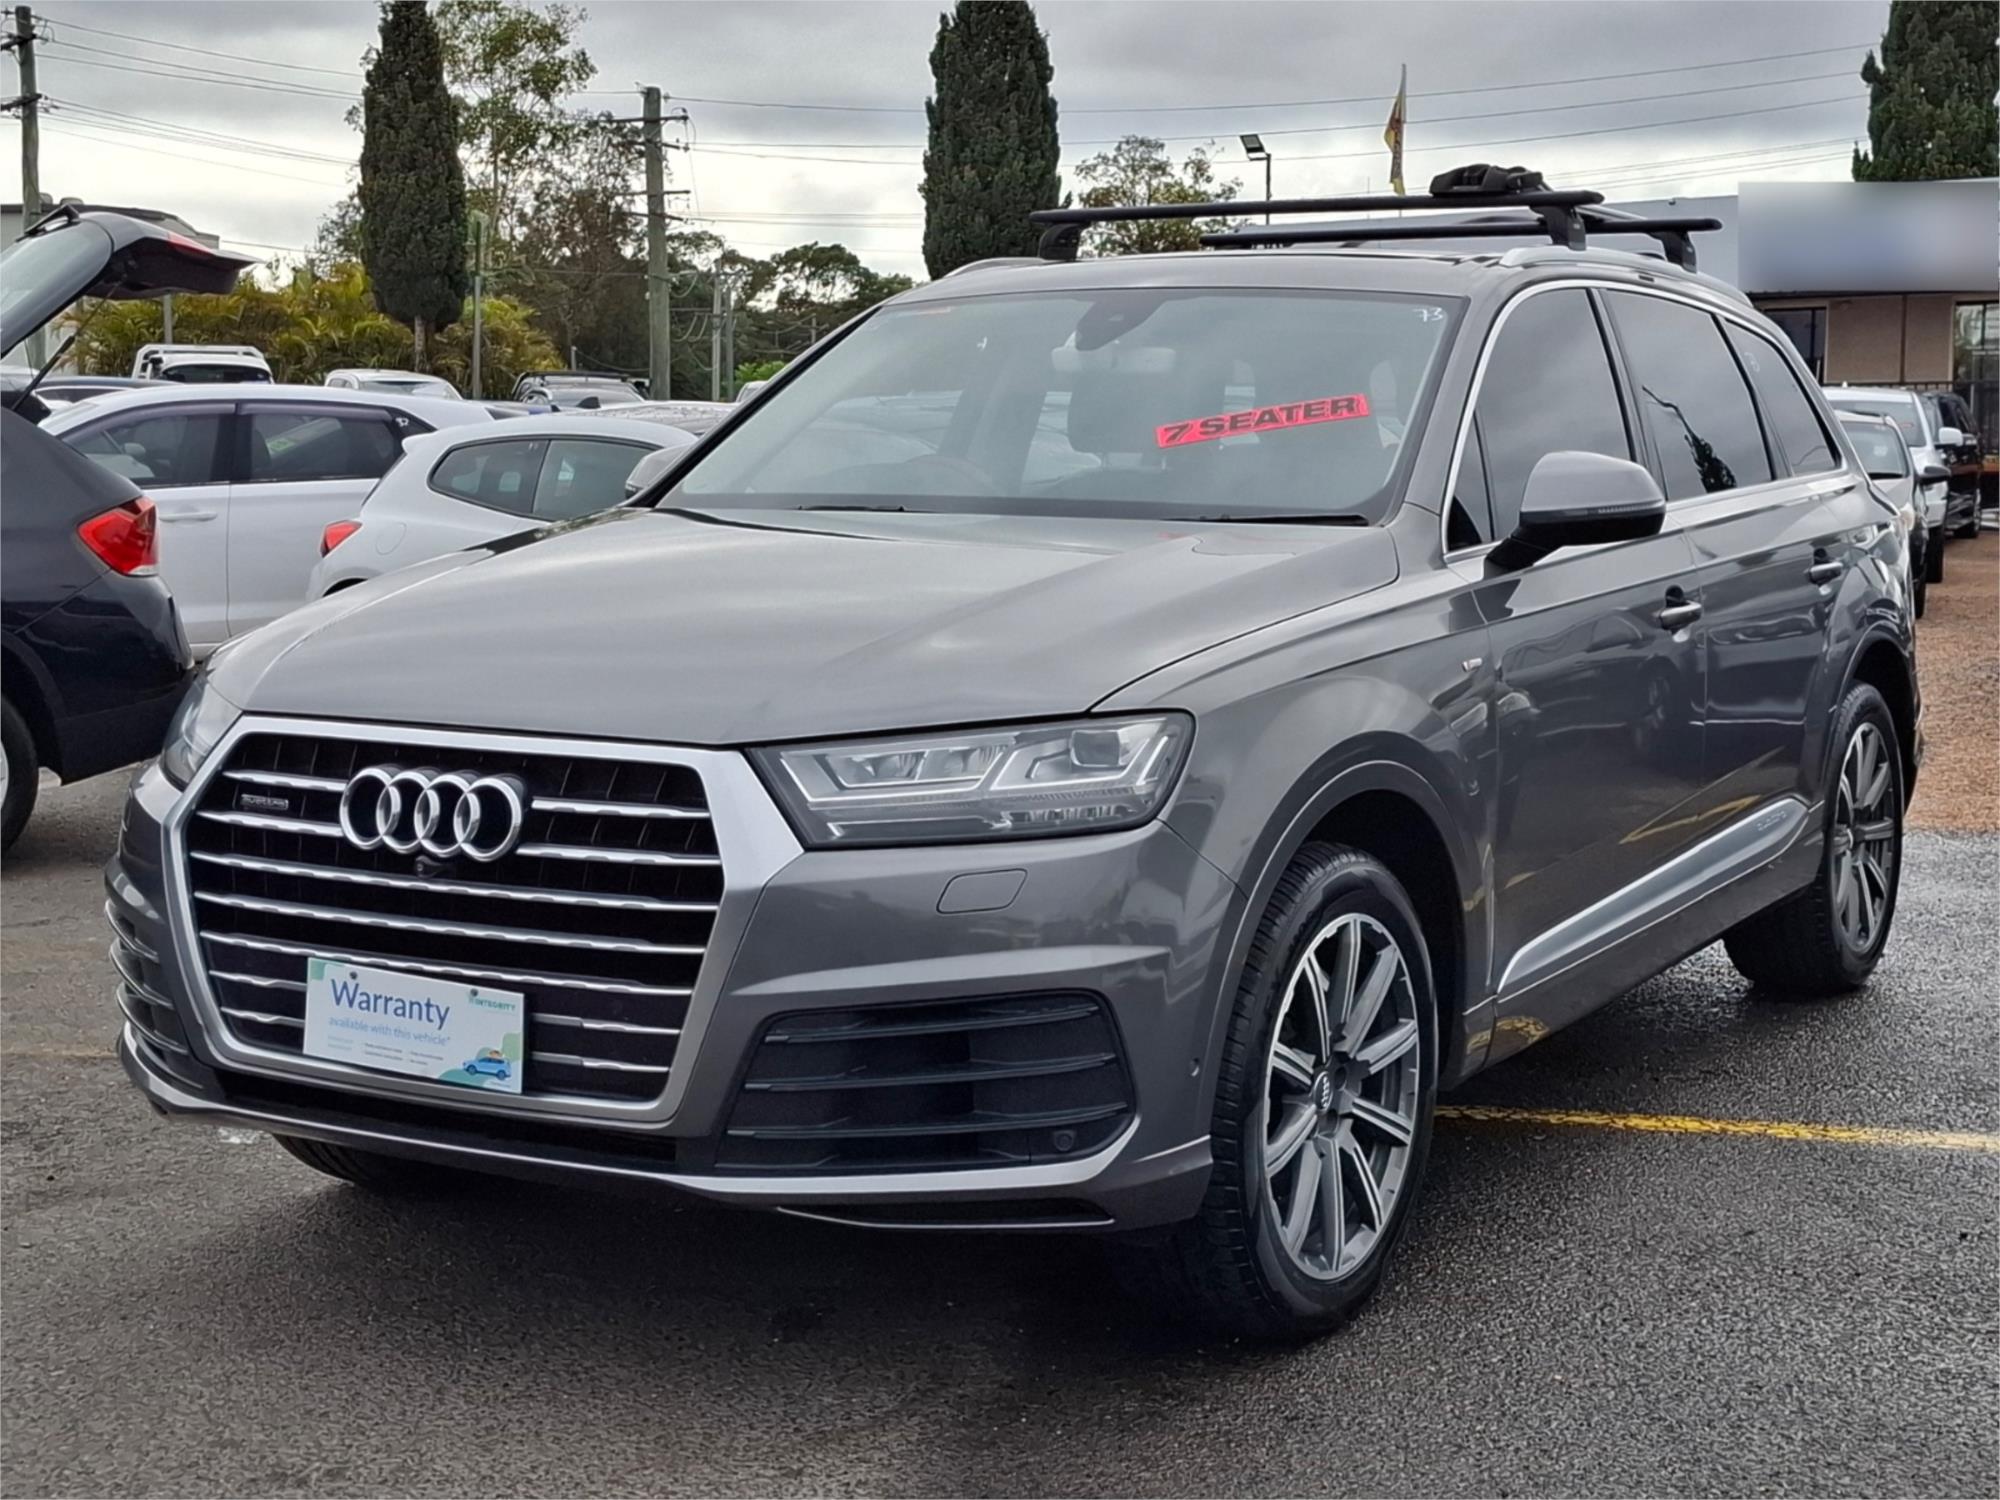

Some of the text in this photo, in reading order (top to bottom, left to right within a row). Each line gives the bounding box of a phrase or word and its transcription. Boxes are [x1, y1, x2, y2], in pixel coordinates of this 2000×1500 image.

[1411, 306, 1444, 322] 73
[1163, 396, 1358, 444] 7 SEATER
[330, 977, 451, 1031] Warranty
[329, 1016, 369, 1033] available
[370, 1023, 393, 1037] with
[393, 1027, 412, 1040] this
